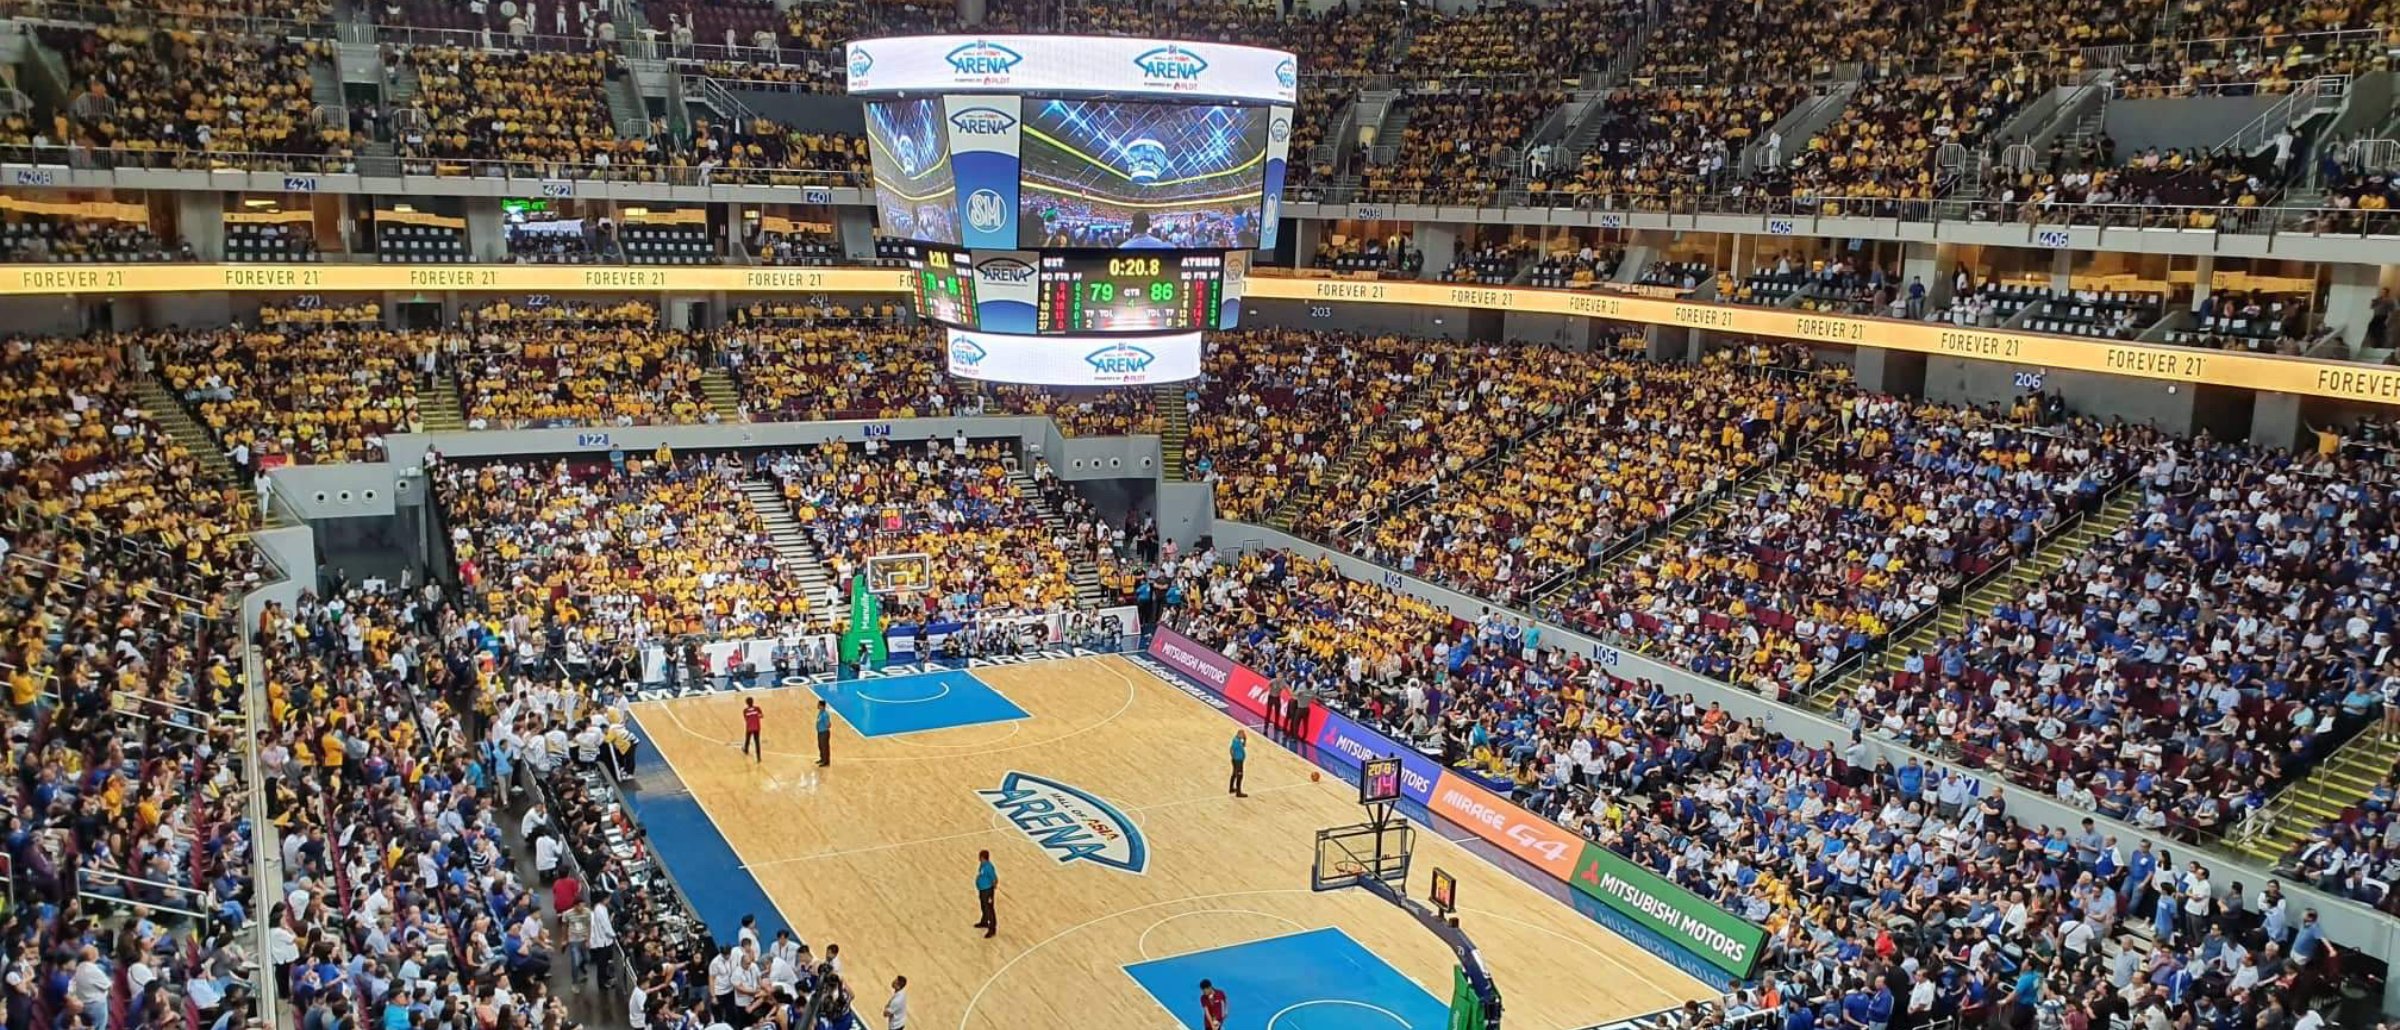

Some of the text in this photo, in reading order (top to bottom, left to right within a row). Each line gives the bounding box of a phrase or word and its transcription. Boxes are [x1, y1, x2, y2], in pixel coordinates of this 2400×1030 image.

[955, 57, 1009, 74] ARENA
[1144, 61, 1197, 80] ARENA
[959, 119, 1007, 134] ARENA
[286, 179, 313, 190] 421
[970, 193, 1001, 227] SM
[1771, 222, 1792, 234] 405
[2040, 233, 2068, 247] 406
[983, 267, 1028, 283] ARENA
[1109, 258, 1160, 276] 0:20.8
[24, 271, 124, 287] FOREVER 21
[225, 270, 319, 285] FOREVER 21
[411, 271, 496, 285] FOREVER 21
[586, 271, 665, 286] FOREVER 21
[748, 273, 822, 286] FOREVER 21
[1090, 283, 1114, 302] 79
[1150, 282, 1174, 300] 86
[1317, 283, 1384, 298] FOREVER 21
[1451, 290, 1513, 306] FOREVER 21
[1311, 307, 1331, 317] 203
[1569, 299, 1619, 315] FOREVER 21
[1675, 307, 1732, 326] FOREVER 21
[1797, 318, 1864, 339] FOREVER 21
[1941, 333, 2020, 356] FOREVER 21
[1095, 357, 1146, 373] ARENA
[2107, 350, 2202, 376] FOREVER 21
[2015, 372, 2042, 388] 206
[583, 433, 606, 446] 122
[1597, 645, 1615, 665] 106
[858, 662, 952, 681] ASIA
[968, 647, 1100, 668] ARENA
[1161, 642, 1228, 685] MITSUBISHI MOTORS
[977, 788, 1107, 863] ARENA
[1087, 818, 1120, 842] ASIA
[1443, 789, 1569, 861] MIRAGE G4
[1600, 872, 1747, 963] MITSUBISHI MOTORS
